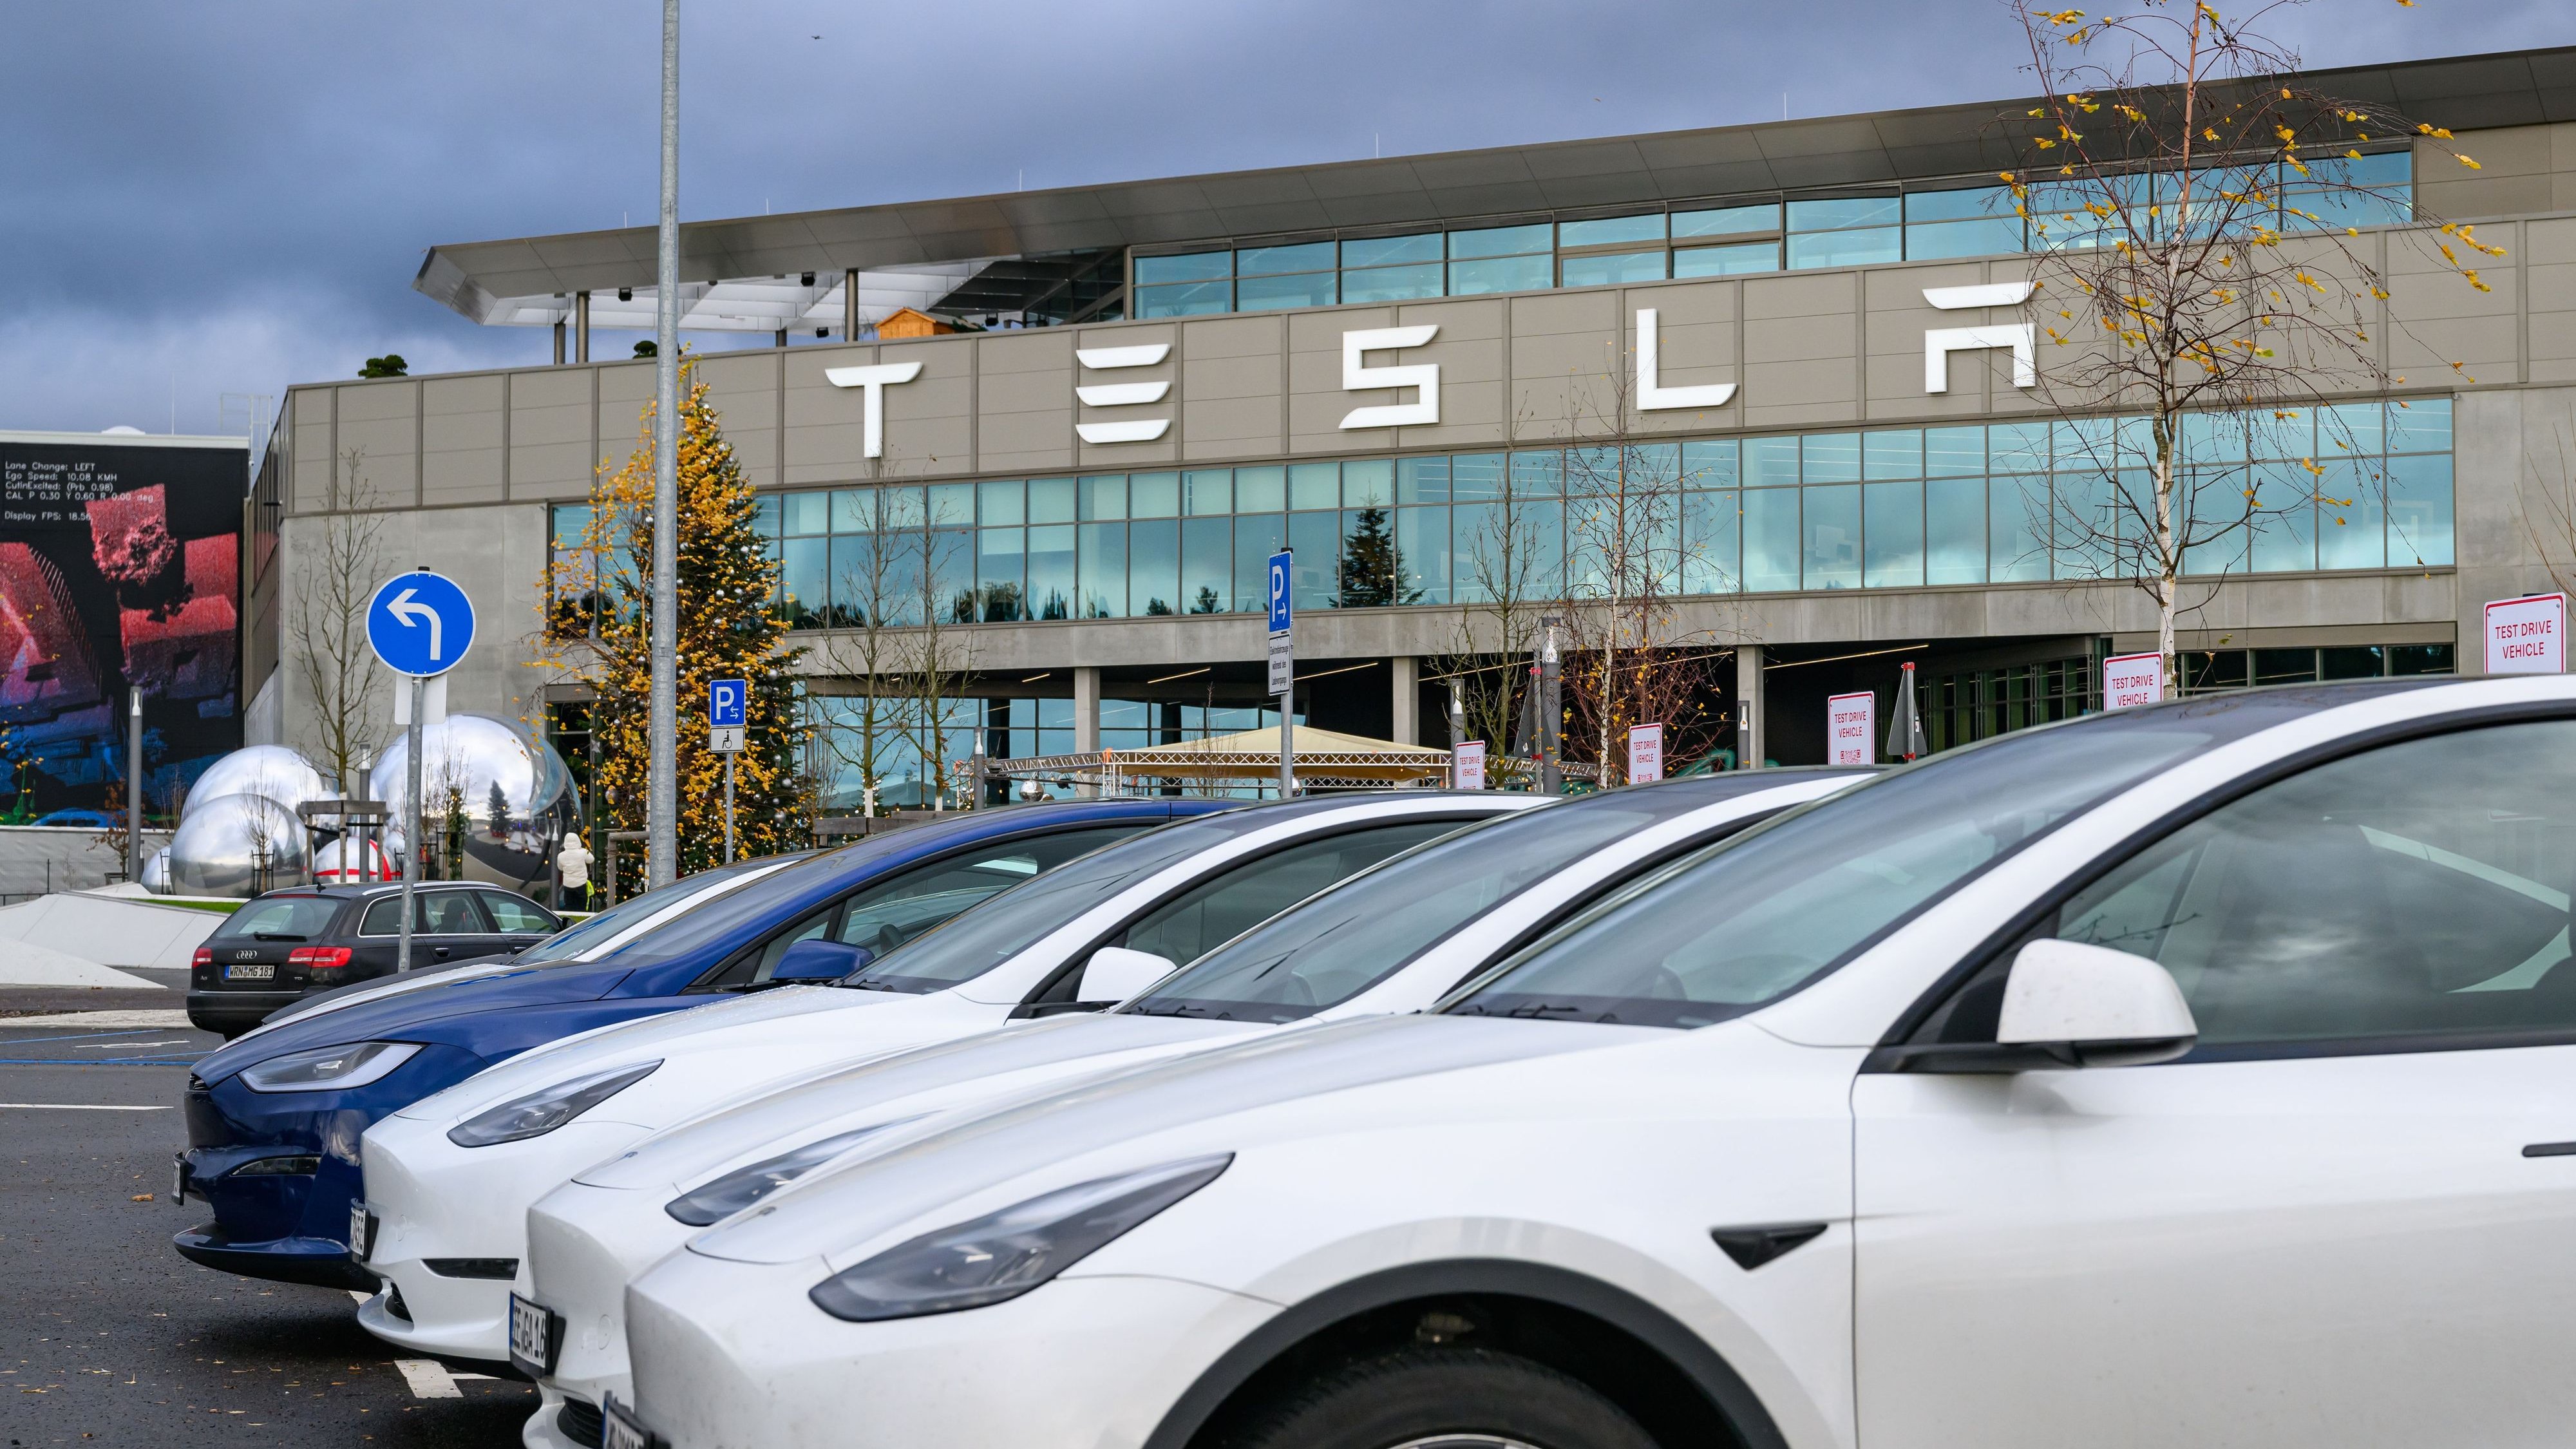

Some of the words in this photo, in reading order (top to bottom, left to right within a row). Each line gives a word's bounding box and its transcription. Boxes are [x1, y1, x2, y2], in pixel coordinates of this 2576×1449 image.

[825, 281, 2036, 458] TESLA
[5, 461, 26, 470] Lane
[32, 462, 68, 473] Change:
[75, 462, 95, 471] LEFT
[6, 471, 23, 482] Ego
[28, 471, 58, 482] Speed:
[68, 473, 91, 482] 10.08
[98, 473, 117, 482] KMH
[67, 482, 85, 491] (Prb
[91, 482, 113, 493] 0.98)
[6, 491, 23, 500] CAL
[29, 491, 35, 499] P
[40, 491, 61, 500] 0.30
[66, 491, 71, 500] Y
[100, 492, 106, 500] R
[111, 492, 131, 501] 0.00
[137, 494, 154, 504] deg
[5, 511, 36, 522] Display
[42, 511, 61, 521] FPS:
[1272, 565, 1284, 623] P
[2495, 624, 2518, 639] TEST
[2521, 620, 2552, 636] DRIVE
[2503, 642, 2544, 659] VEHICLE
[2112, 677, 2128, 690] TEST
[2131, 674, 2154, 688] DRIVE
[716, 687, 734, 720] P
[2117, 692, 2148, 706] VEHICLE
[1835, 713, 1848, 724] TEST
[1849, 711, 1866, 722] DRIVE
[1839, 726, 1862, 738] VEHICLE
[1633, 741, 1643, 751] TEST
[1644, 739, 1656, 750] DRIVE
[1460, 757, 1468, 766] TEST
[1469, 755, 1480, 764] DRIVE
[1636, 753, 1654, 764] VEHICLE
[1462, 768, 1477, 777] VEHICLE
[229, 966, 243, 977] WRN
[247, 966, 258, 977] MG
[259, 966, 273, 977] 181
